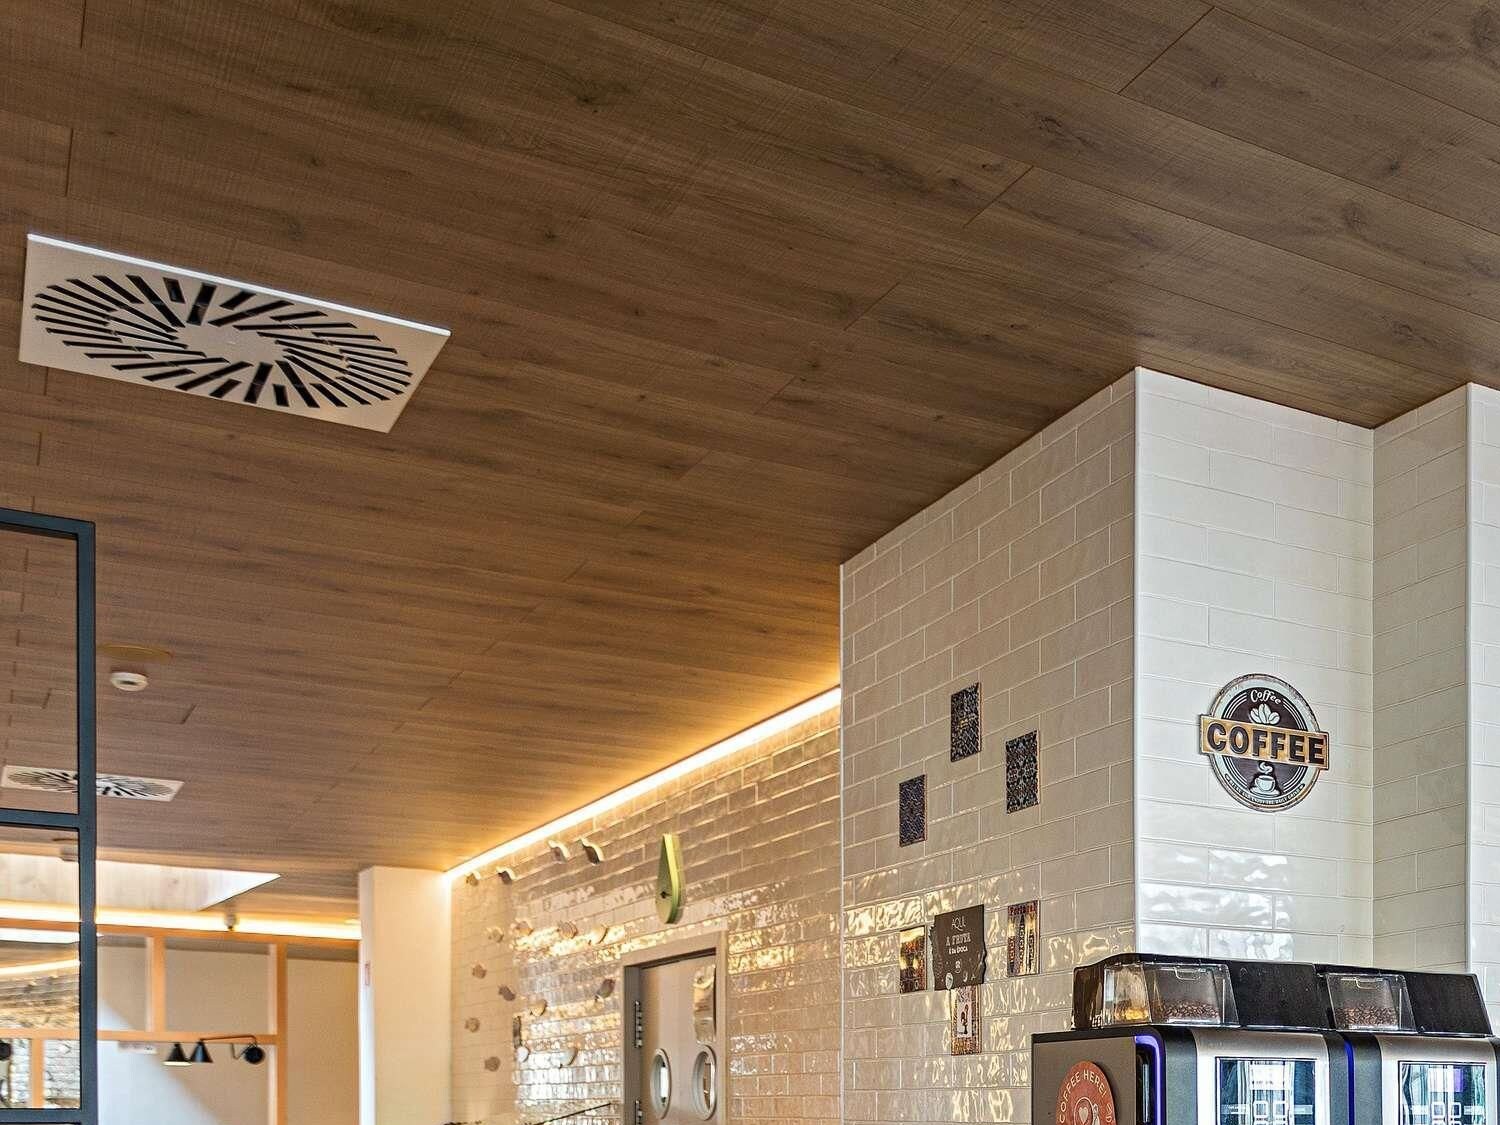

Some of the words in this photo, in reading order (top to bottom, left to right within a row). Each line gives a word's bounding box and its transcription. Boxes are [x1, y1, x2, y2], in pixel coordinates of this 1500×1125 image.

[1250, 689, 1281, 705] Coffee
[1207, 722, 1325, 765] COFFEE
[1059, 1071, 1081, 1124] COFFEE
[1083, 1069, 1107, 1098] HERE!
